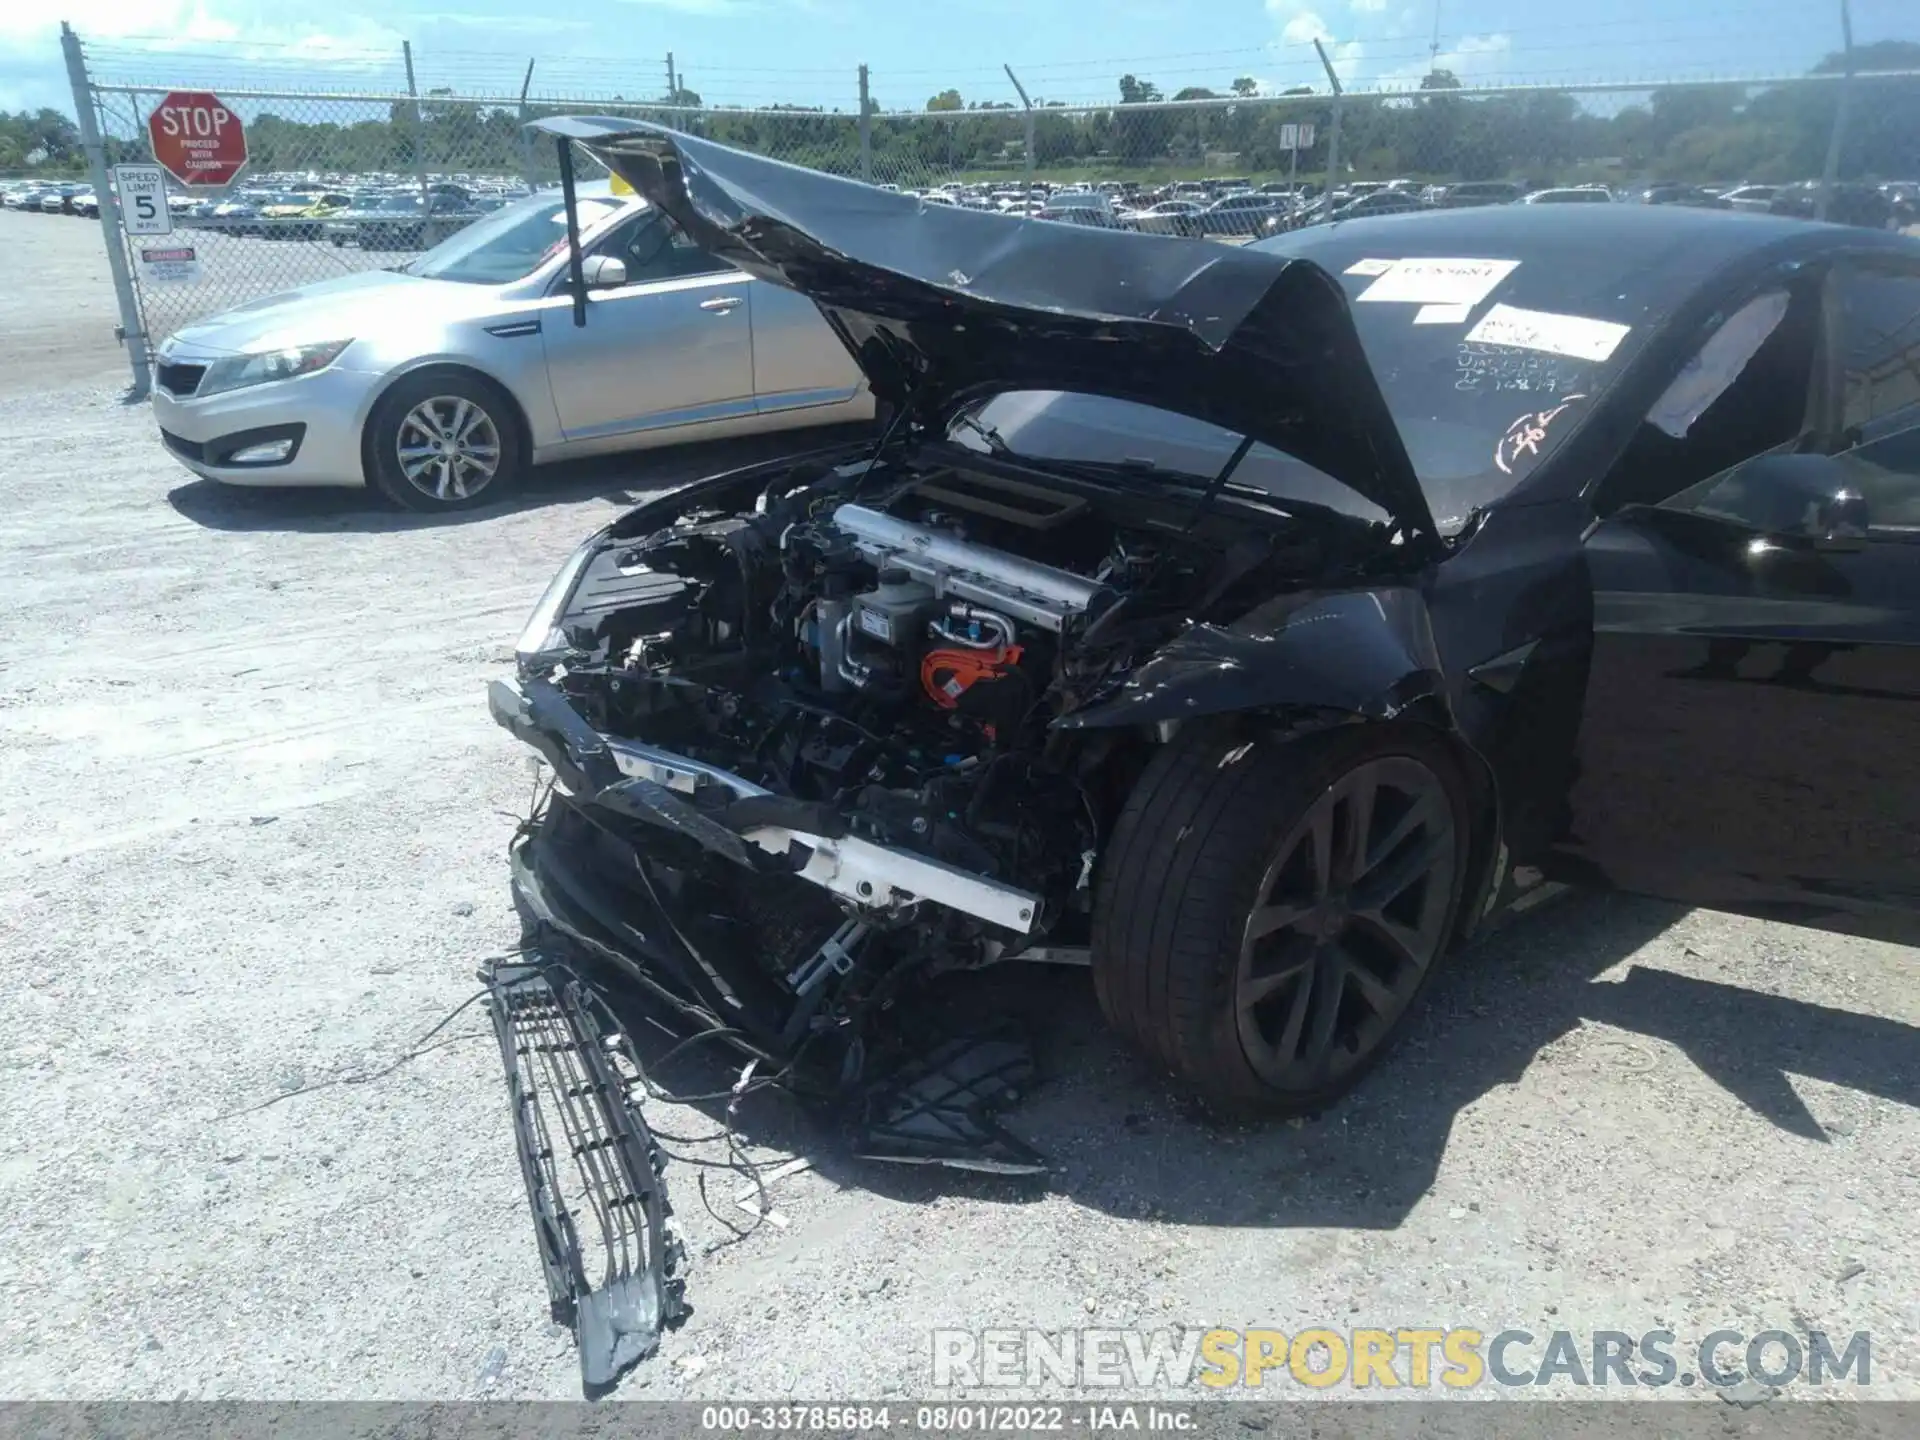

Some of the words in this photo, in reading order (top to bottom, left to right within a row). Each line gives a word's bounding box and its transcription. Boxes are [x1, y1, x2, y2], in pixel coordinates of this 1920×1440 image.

[161, 107, 229, 136] STOP
[180, 139, 220, 149] PROCEED
[190, 149, 213, 159] WITH
[184, 160, 222, 170] CAUTION
[120, 172, 160, 182] SPEED
[127, 183, 156, 193] LIMIT
[136, 196, 156, 219] 5
